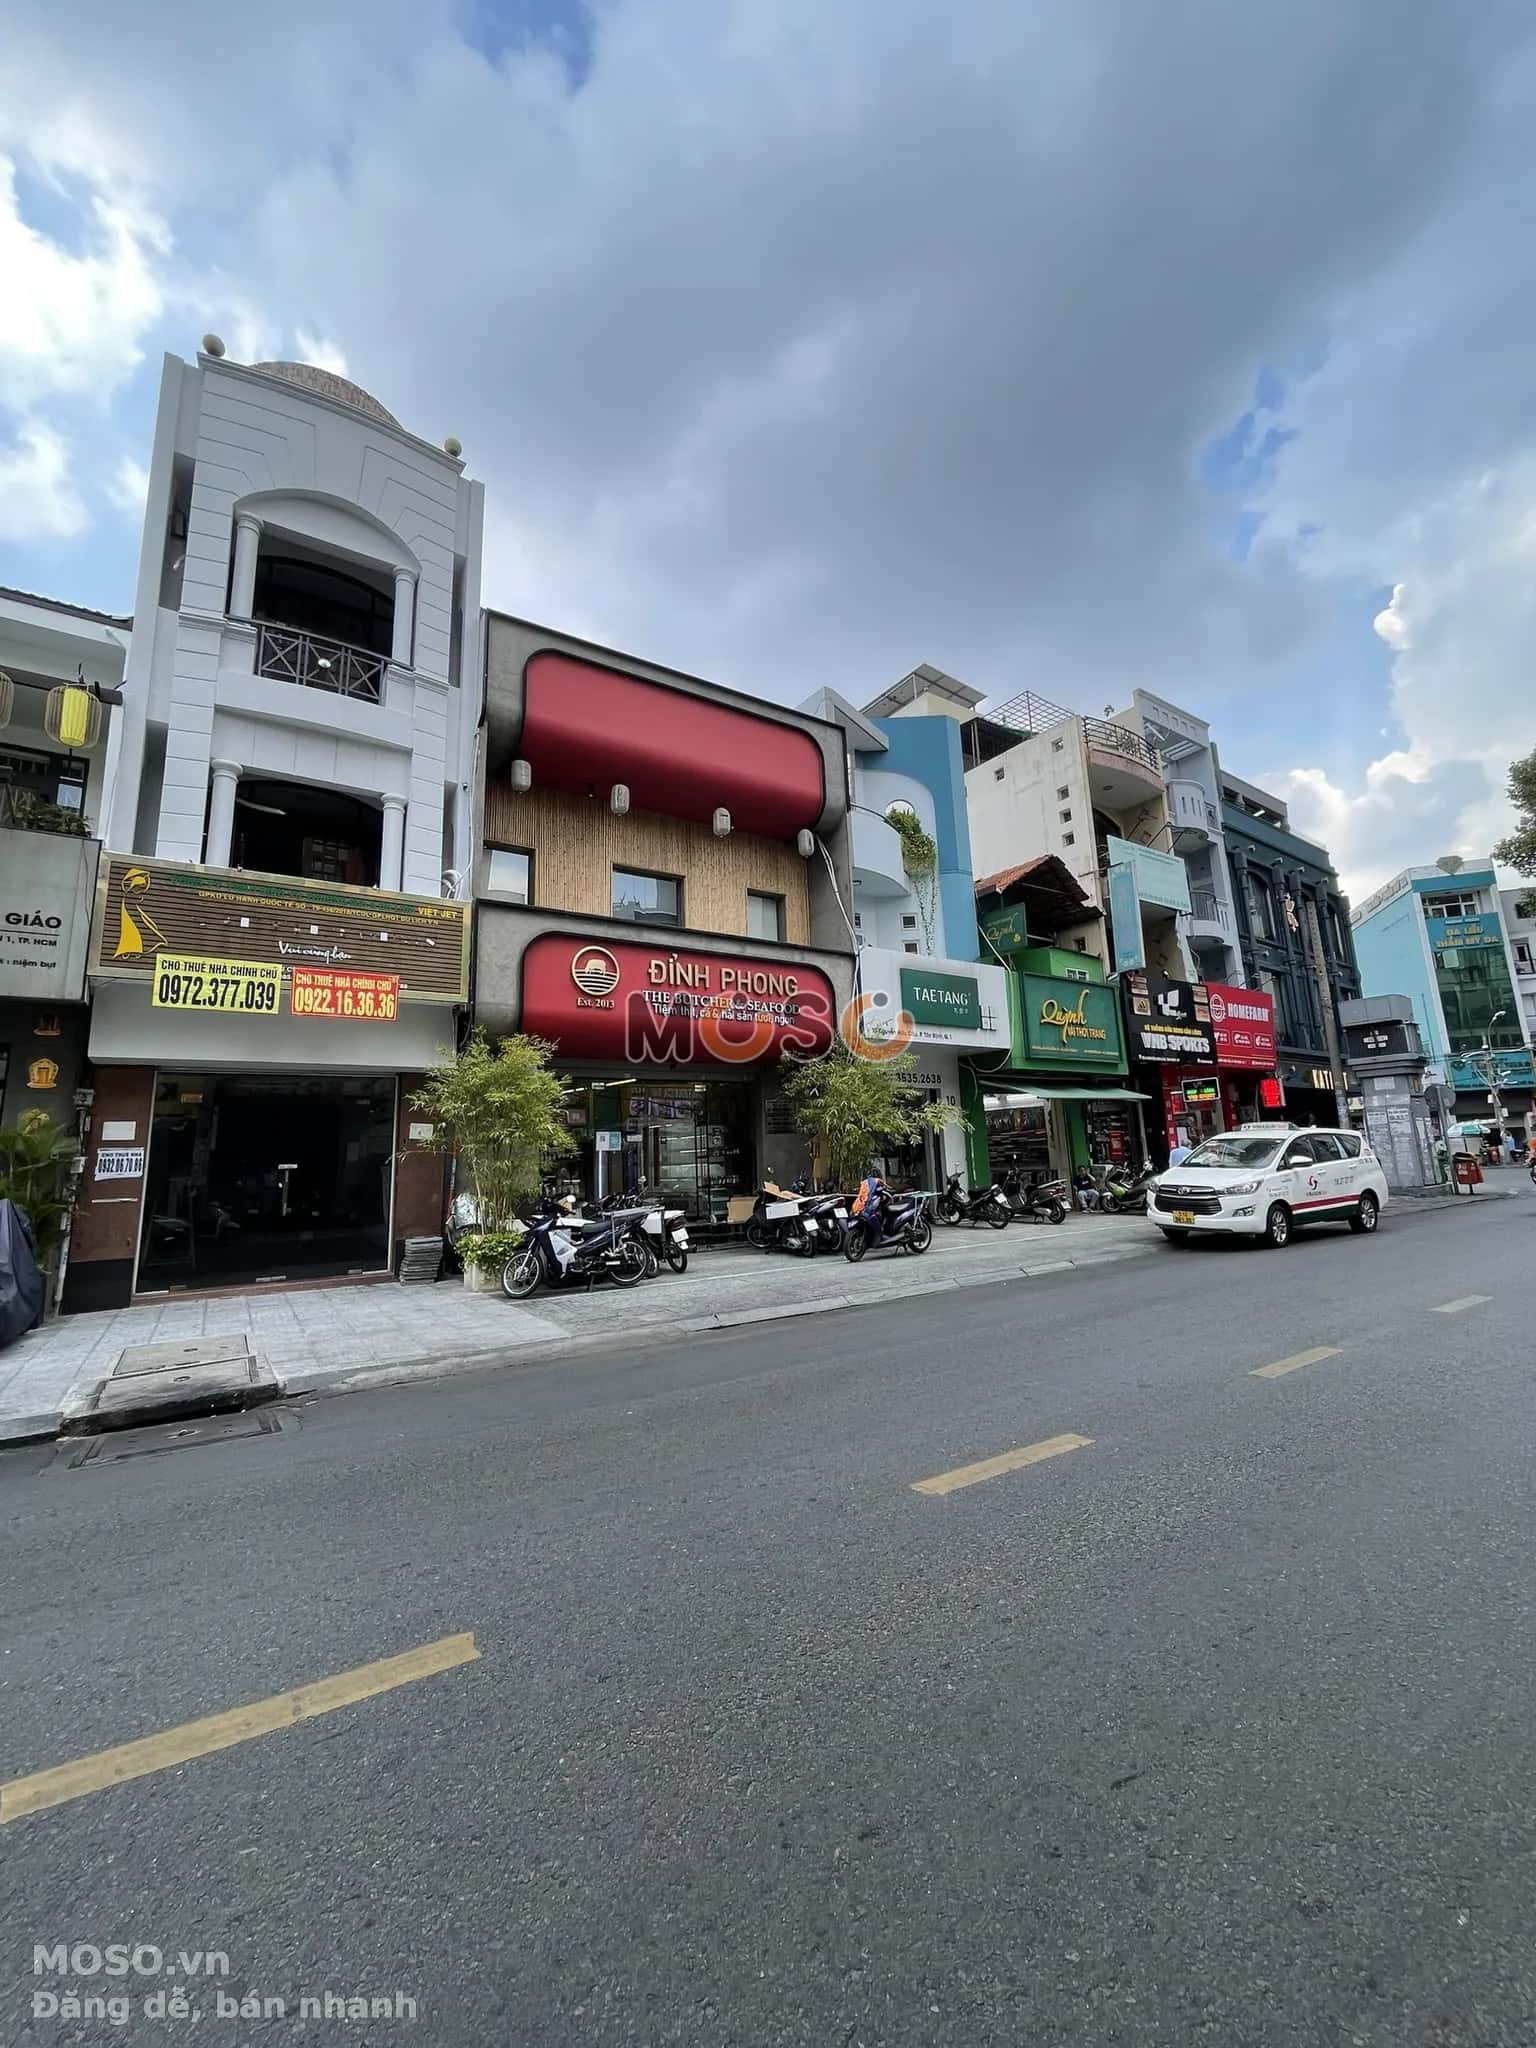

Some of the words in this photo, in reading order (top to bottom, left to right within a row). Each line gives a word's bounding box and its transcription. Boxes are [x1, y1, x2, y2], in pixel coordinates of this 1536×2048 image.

[5, 910, 62, 929] GIÁO
[33, 938, 57, 947] HCM
[161, 960, 180, 971] CHO
[184, 961, 207, 974] THUÊ
[208, 962, 228, 974] NHÀ
[230, 964, 257, 978] CHÍNH
[260, 966, 278, 979] CHỦ
[648, 953, 710, 988] ĐỈNH
[721, 968, 799, 997] PHONG
[296, 973, 312, 985] CHO
[314, 974, 333, 987] THUÊ
[335, 975, 350, 988] NHÀ
[352, 977, 376, 990] CHÍNH
[159, 974, 276, 1010] 0972.377.039
[913, 986, 969, 1006] TAETANG
[295, 987, 395, 1018] 0922.16.36.36
[577, 997, 594, 1007] Est.
[595, 998, 615, 1008] 2013
[643, 990, 671, 1002] THE
[675, 992, 734, 1009] BUTCHER
[747, 1000, 800, 1015] SEAFOOD
[1040, 988, 1090, 1044] Quỳnh
[1141, 1032, 1167, 1050] VNB
[1168, 1035, 1210, 1053] SPORTS
[946, 1095, 956, 1106] 10
